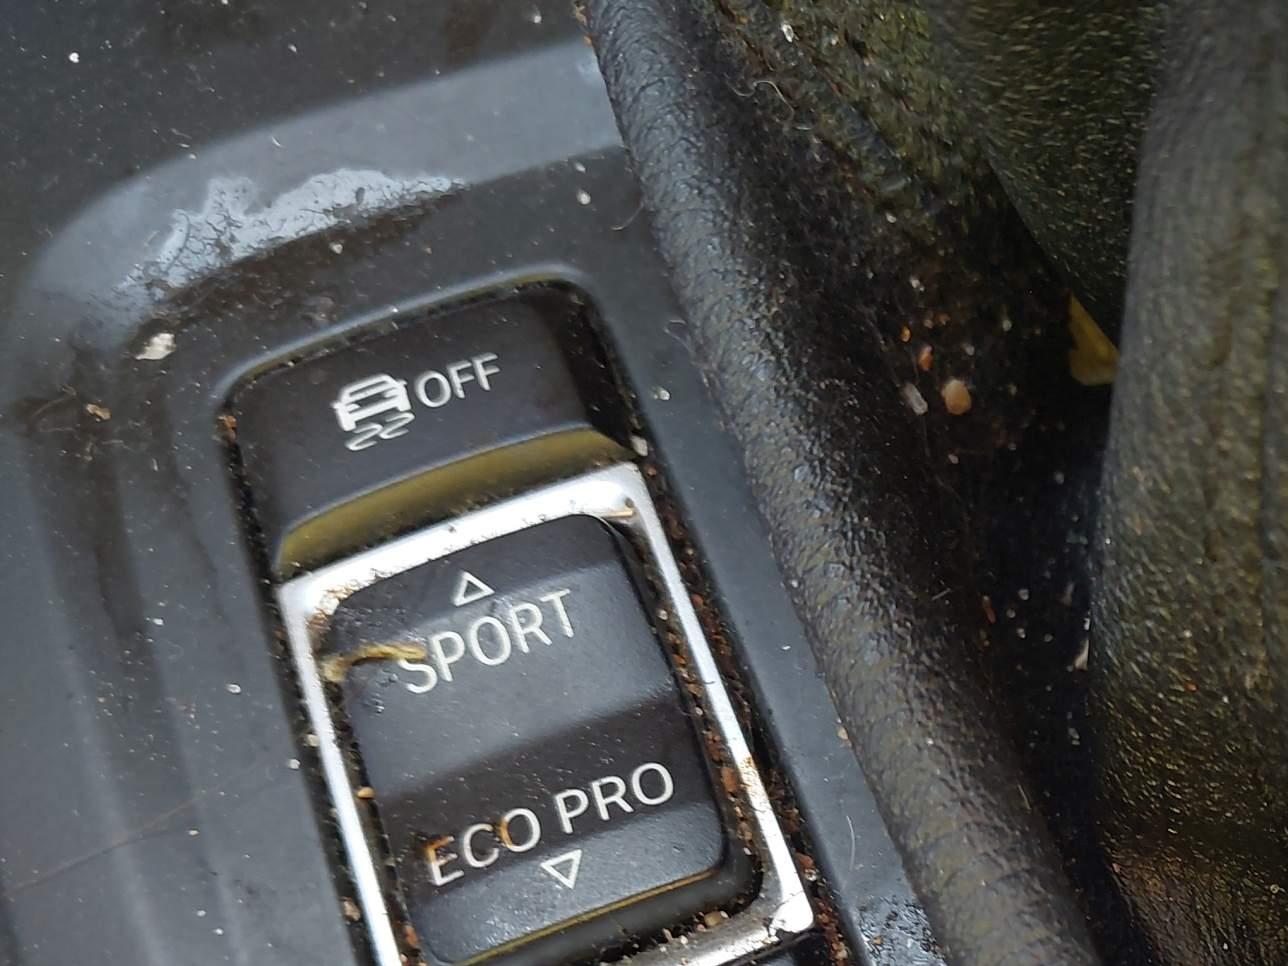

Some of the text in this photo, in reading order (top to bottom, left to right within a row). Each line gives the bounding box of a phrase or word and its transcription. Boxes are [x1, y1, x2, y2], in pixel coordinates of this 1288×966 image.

[414, 352, 501, 410] OFF
[398, 587, 578, 694] SPORT
[423, 761, 676, 887] ECO PRO
